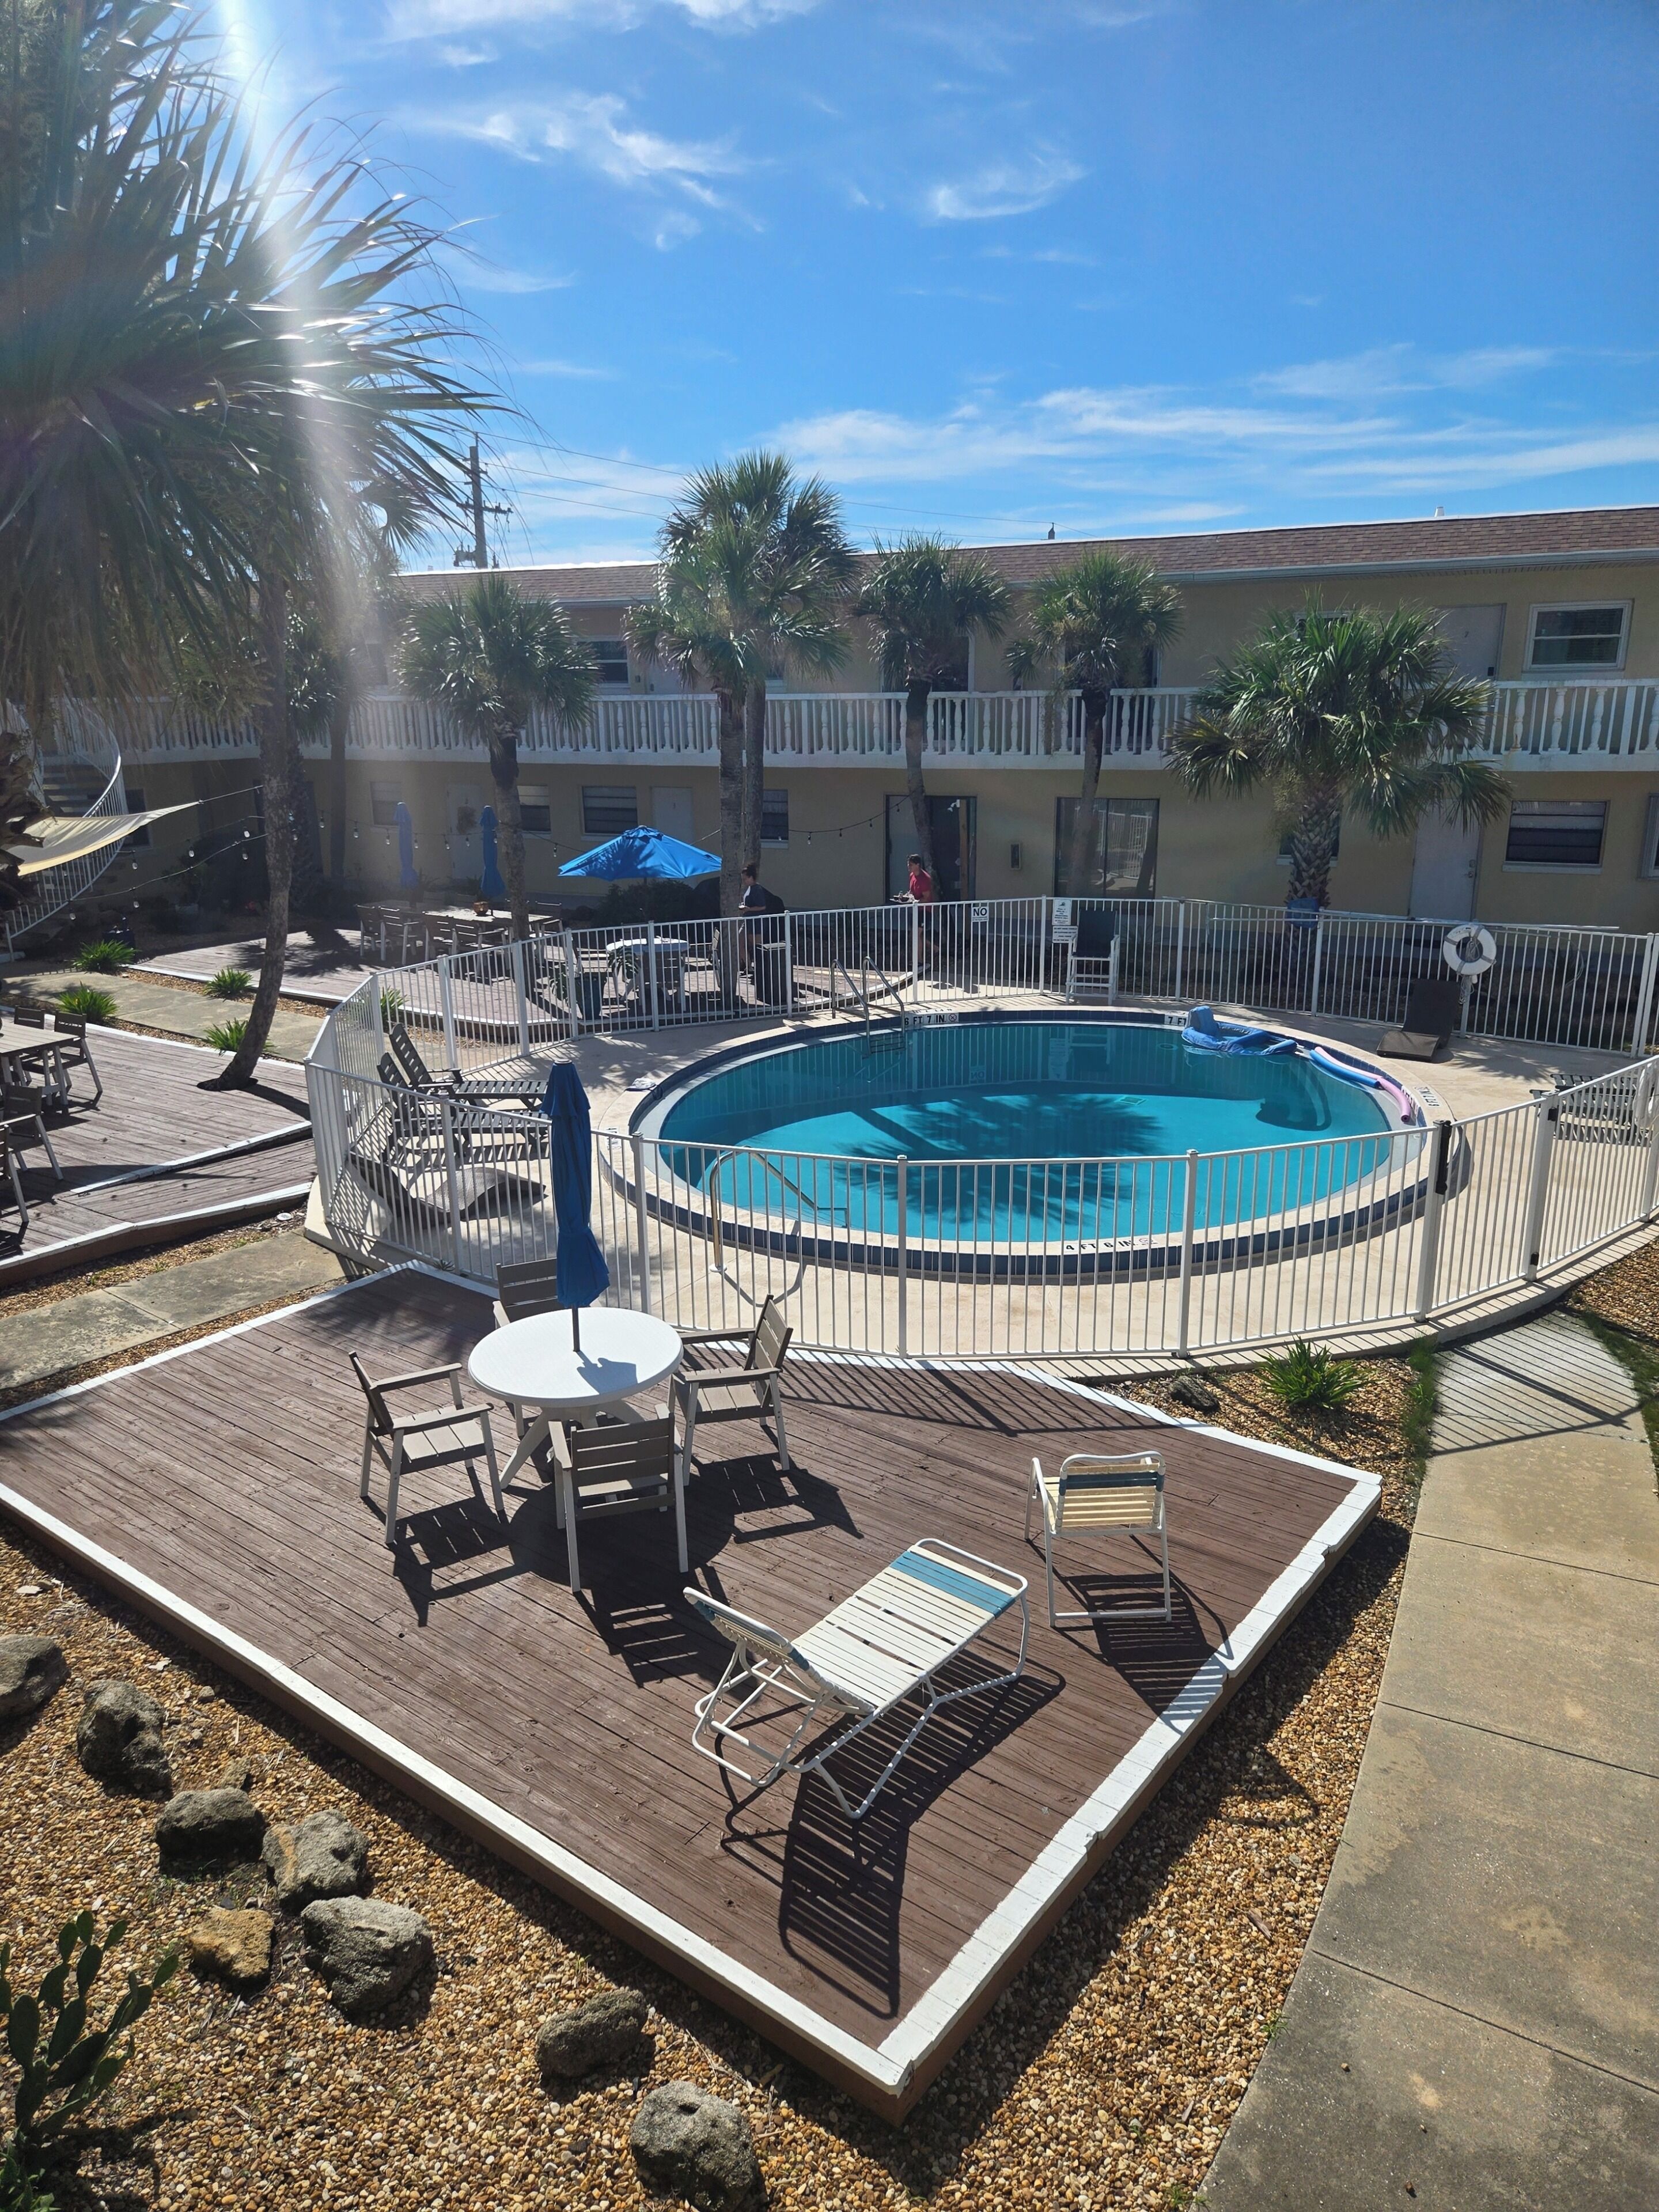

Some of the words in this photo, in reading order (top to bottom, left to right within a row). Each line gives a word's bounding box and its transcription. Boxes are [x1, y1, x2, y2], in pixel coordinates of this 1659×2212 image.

[974, 908, 987, 916] NO
[904, 1017, 909, 1025] 6
[913, 1016, 923, 1025] FT
[1168, 1016, 1173, 1024] 7
